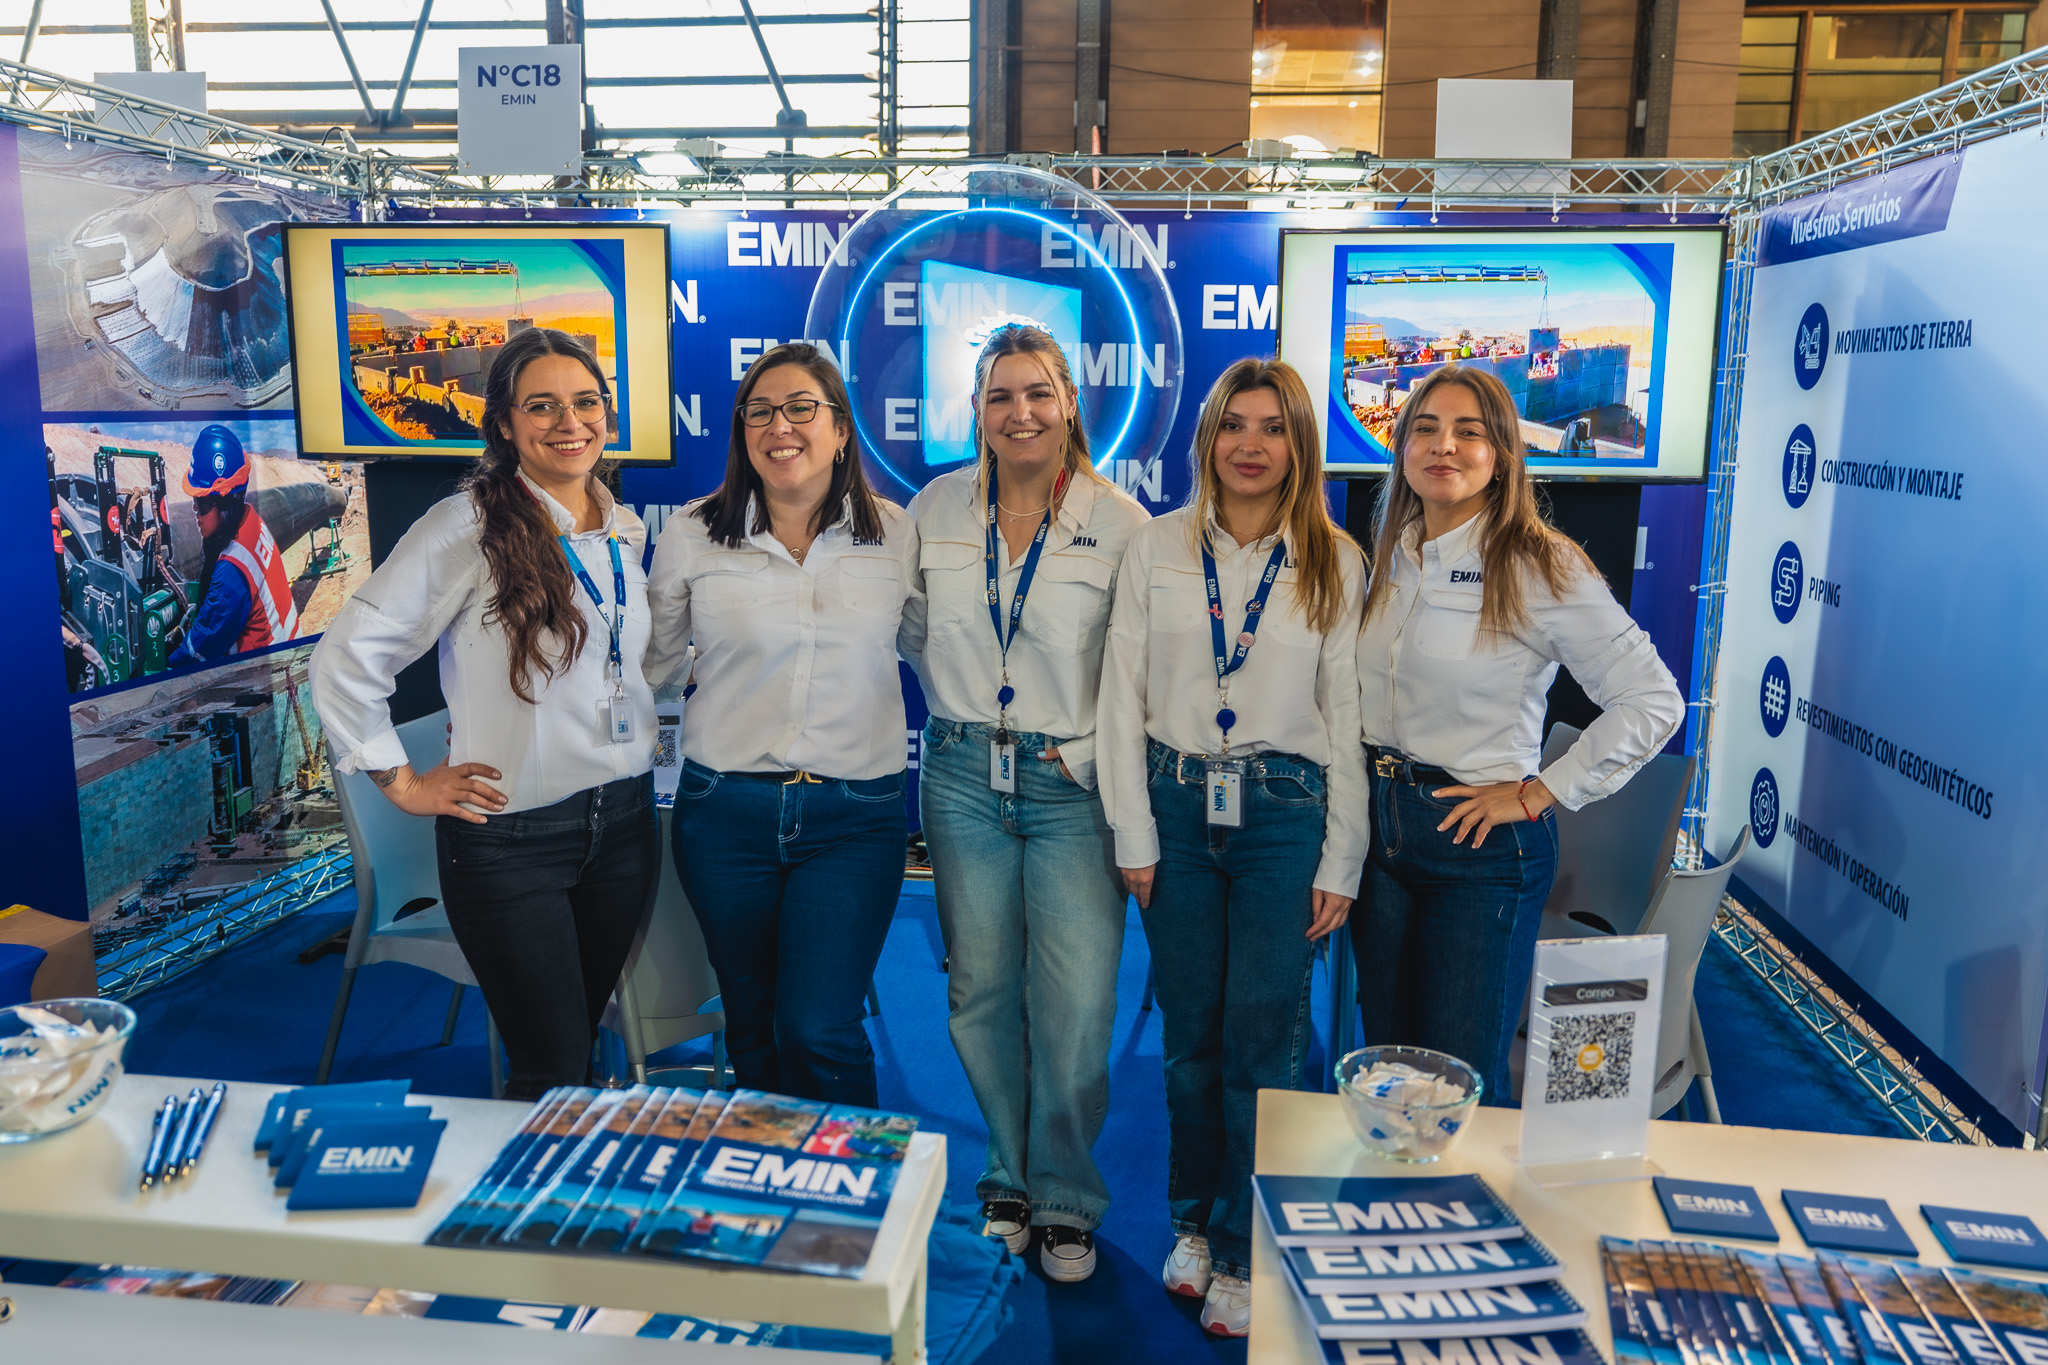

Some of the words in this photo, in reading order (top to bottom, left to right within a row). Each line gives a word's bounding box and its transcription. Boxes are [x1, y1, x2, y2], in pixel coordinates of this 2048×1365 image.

[501, 94, 536, 105] EMIN
[1791, 211, 1841, 245] Nuestros
[1842, 192, 1902, 234] Servicios
[727, 222, 849, 266] EMIN
[1041, 224, 1168, 269] EMIN
[1203, 284, 1278, 330] EM
[1834, 324, 1908, 354] MOVIMIENTOS
[1910, 322, 1926, 350] DE
[1928, 319, 1972, 349] TIERRA
[1821, 459, 1896, 491] CONSTRUCCIÓN
[1898, 466, 1906, 492] Y
[1906, 467, 1964, 500] MONTAJE
[1036, 523, 1047, 543] EMIN
[1070, 536, 1097, 547] MIN
[1207, 578, 1218, 599] EMIN
[1264, 564, 1278, 583] EMIN
[1809, 576, 1841, 608] PIPING
[1796, 697, 1874, 756] REVESTIMIENTOS
[1875, 737, 1898, 769] CON
[1899, 749, 1993, 820] GEOSINTÉTICOS
[1214, 785, 1223, 812] EMIN
[1784, 812, 1841, 872] MANTENCIÓN
[1842, 851, 1850, 876] Y
[1850, 859, 1909, 921] OPERACIÓN
[1576, 986, 1616, 1000] Correo
[319, 1145, 415, 1168] EMIN
[706, 1146, 878, 1198] EMIN
[1281, 1201, 1479, 1230] EMIN
[1672, 1193, 1749, 1213] EMIN
[1803, 1206, 1884, 1227] EMIN
[1945, 1220, 2031, 1241] EMIN
[1306, 1241, 1516, 1275] EMIN
[1321, 1285, 1539, 1320] EMIN
